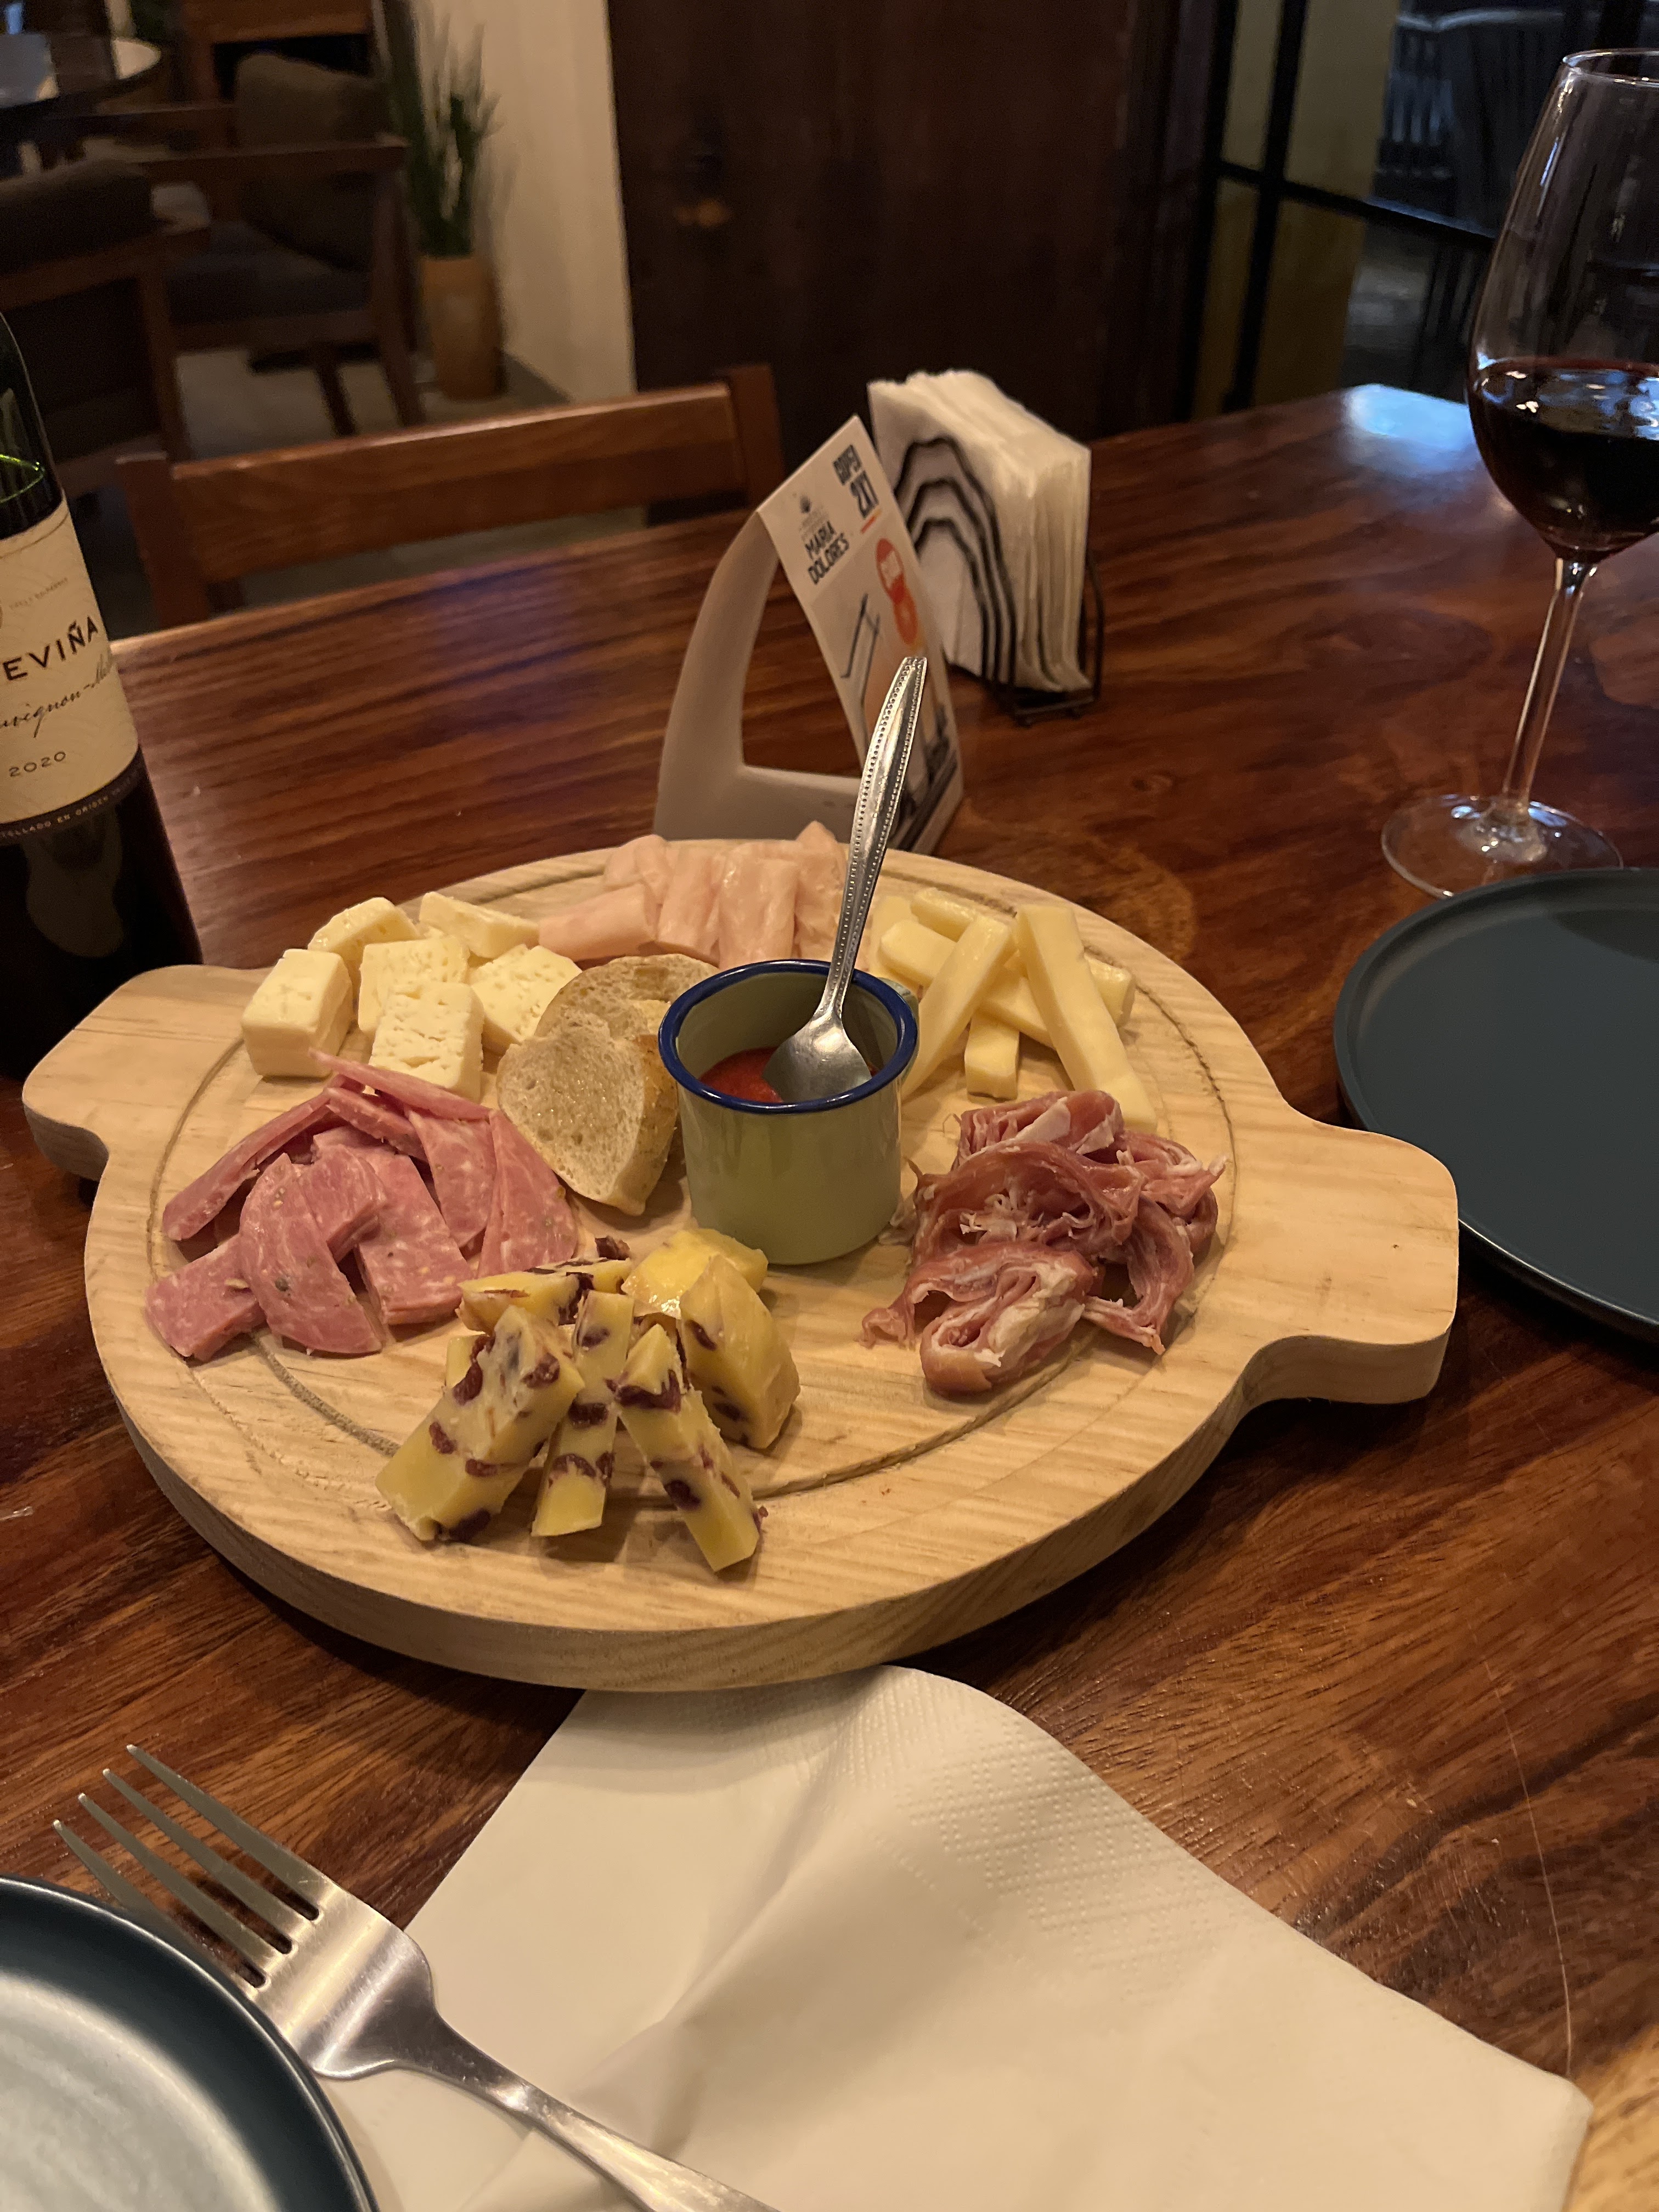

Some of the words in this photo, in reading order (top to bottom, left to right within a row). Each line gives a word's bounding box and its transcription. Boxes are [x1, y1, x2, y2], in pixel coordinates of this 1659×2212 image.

[808, 533, 849, 585] DOLORES
[3, 616, 99, 681] EVIÑA
[8, 751, 66, 777] 2020
